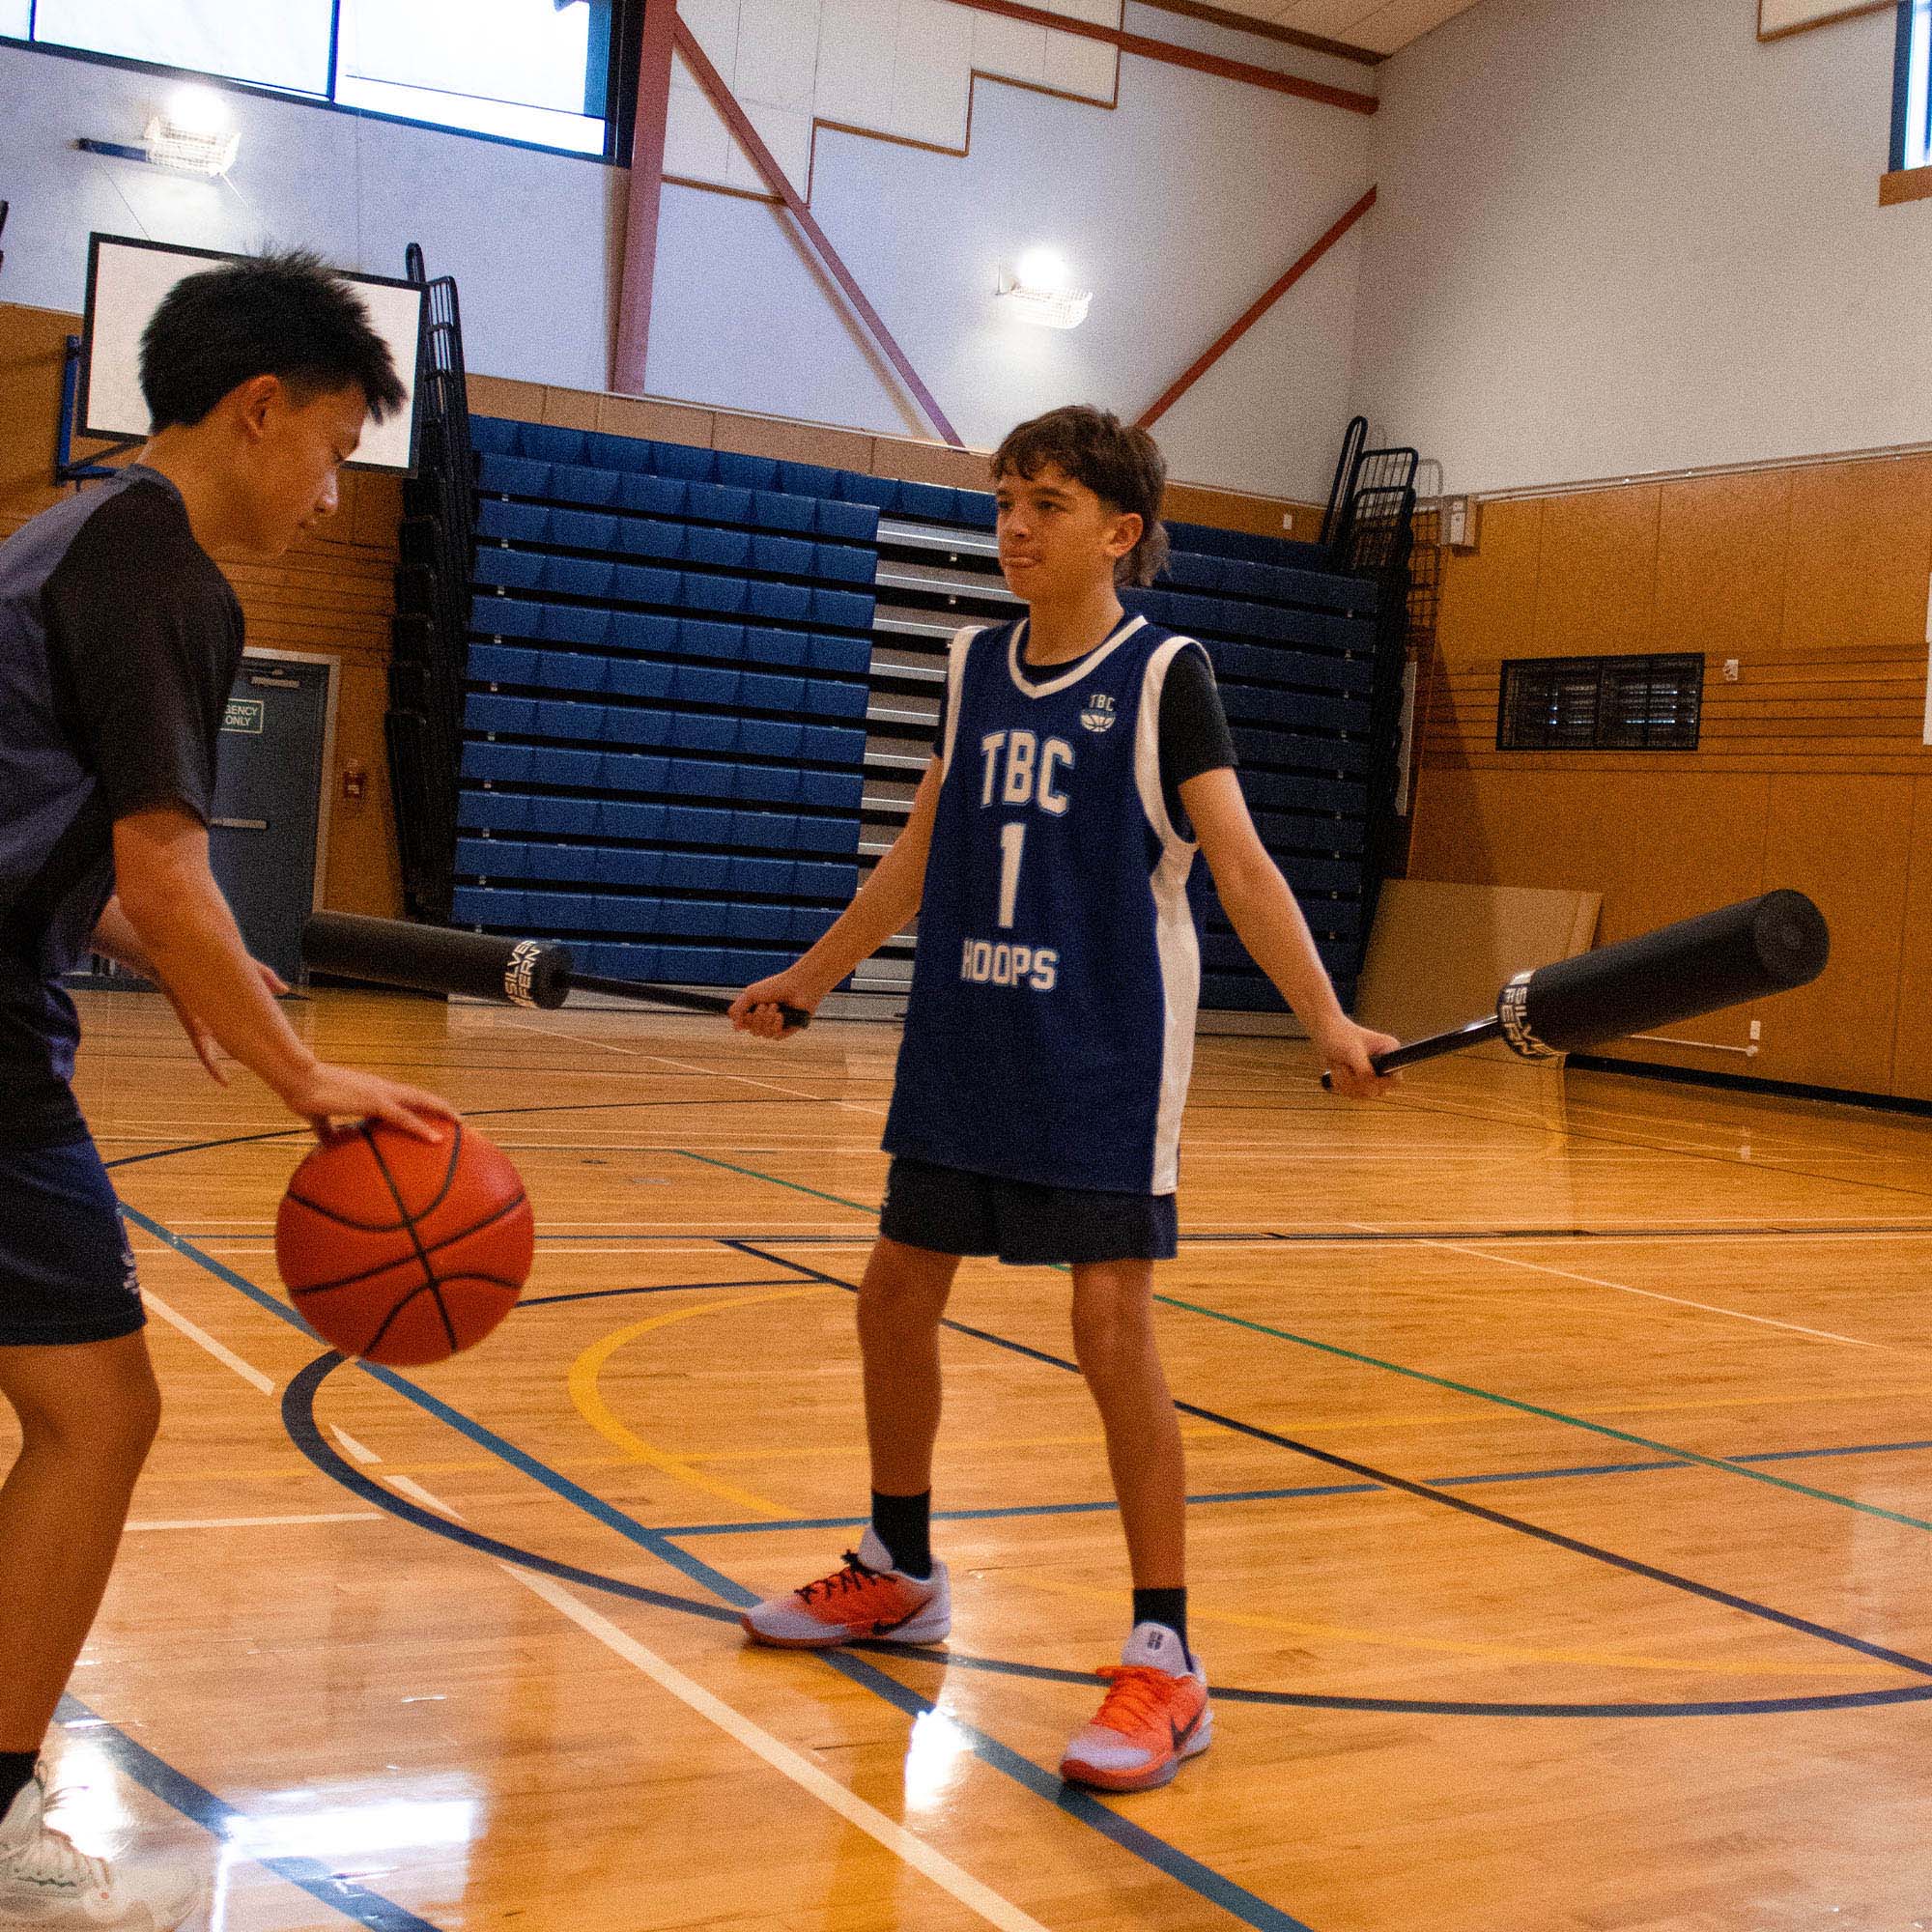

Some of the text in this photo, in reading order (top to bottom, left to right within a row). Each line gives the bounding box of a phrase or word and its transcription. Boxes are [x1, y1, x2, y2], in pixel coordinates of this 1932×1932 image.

[225, 715, 251, 726] ONLY
[1089, 694, 1115, 712] TBC
[980, 729, 1076, 816] TBC
[998, 822, 1027, 928] 1
[519, 948, 541, 1001] FERN
[960, 937, 1060, 992] HOOPS
[1501, 987, 1537, 1056] FERN
